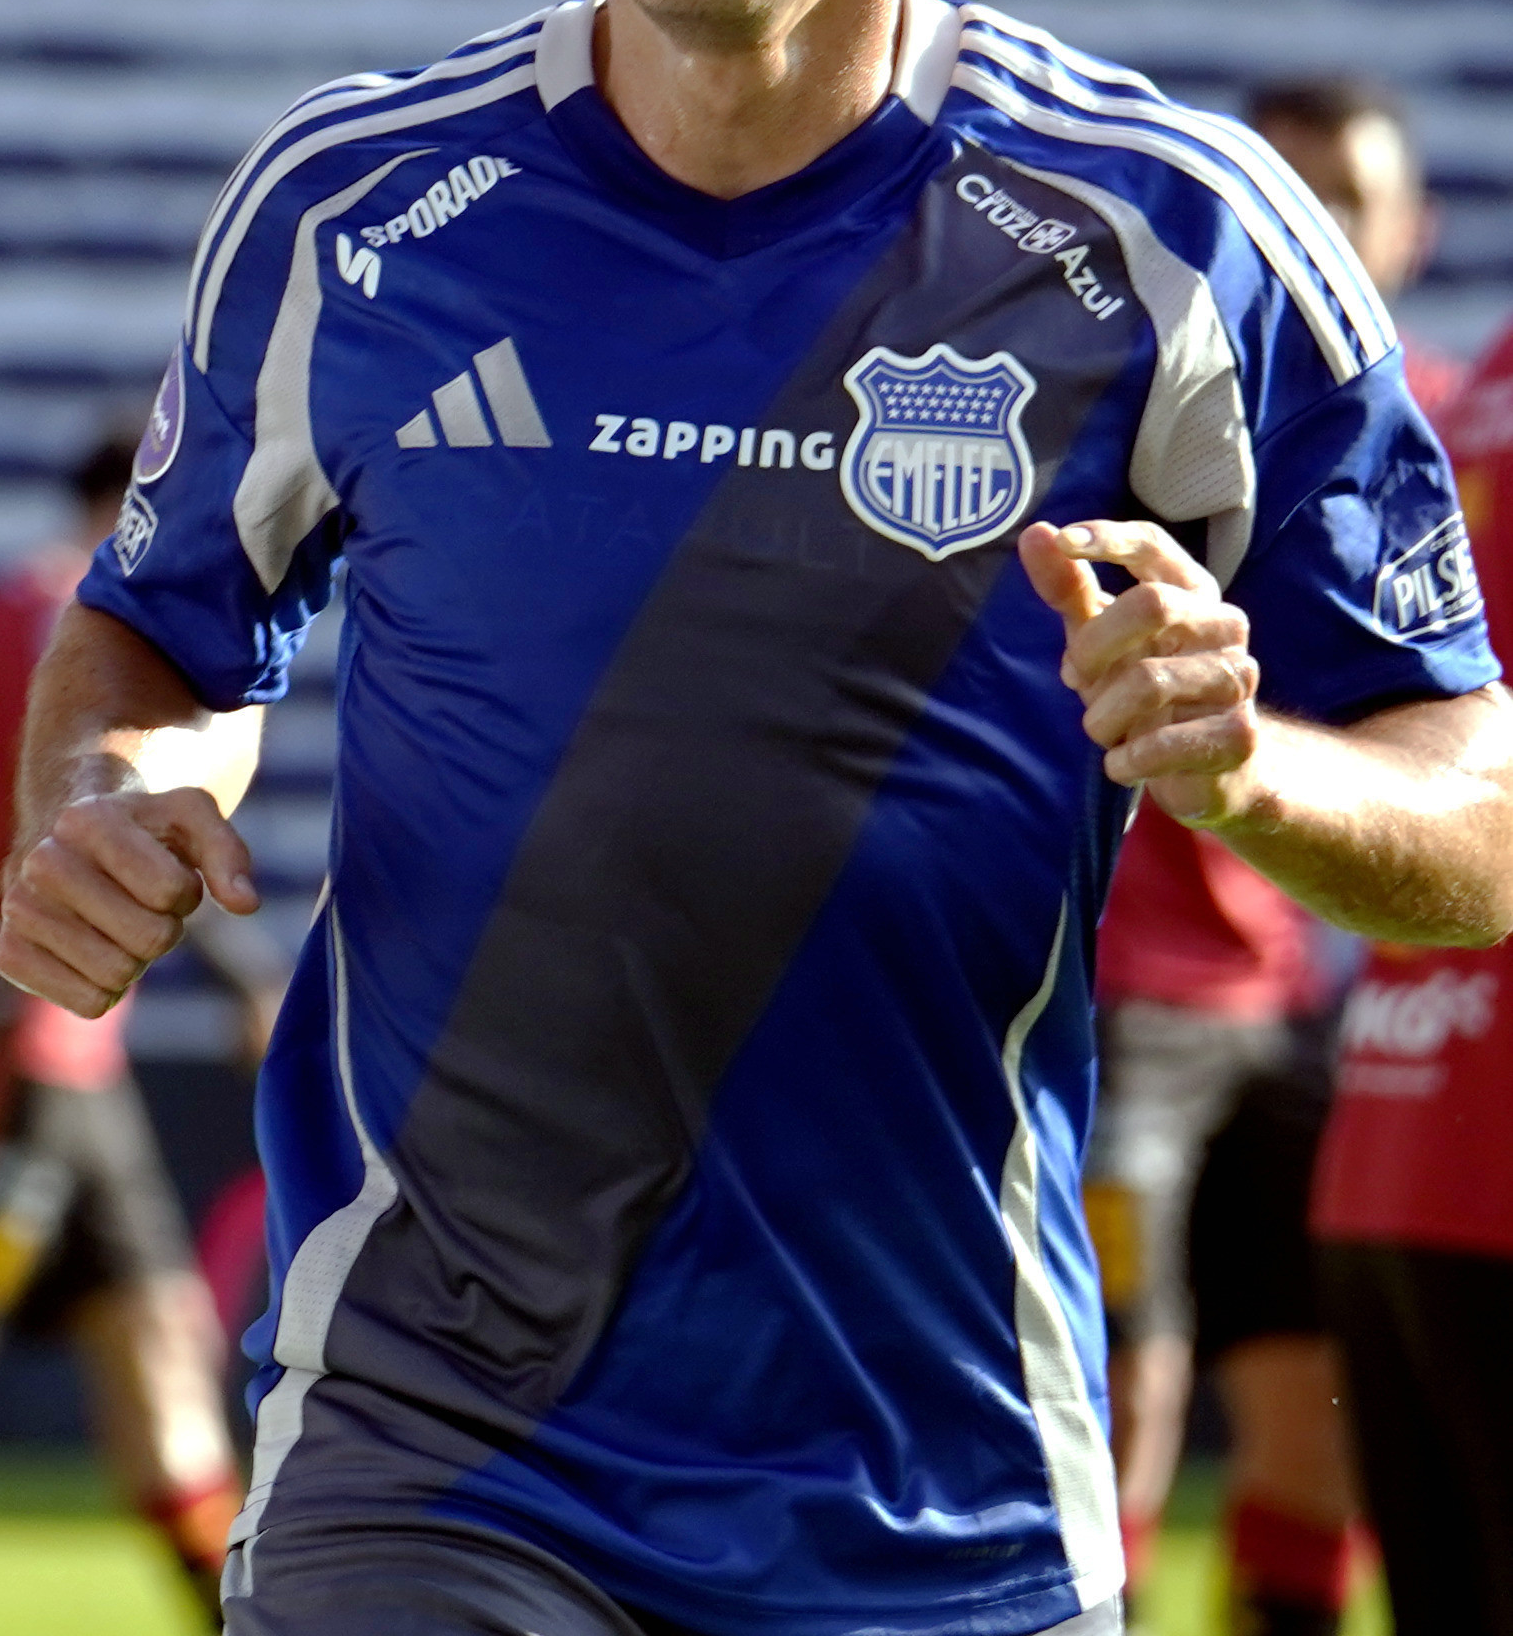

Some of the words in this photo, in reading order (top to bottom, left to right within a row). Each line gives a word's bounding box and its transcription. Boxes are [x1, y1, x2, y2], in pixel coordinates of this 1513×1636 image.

[955, 173, 1034, 241] Cruz
[1053, 244, 1125, 322] Azul
[866, 439, 1008, 536] EMELEC
